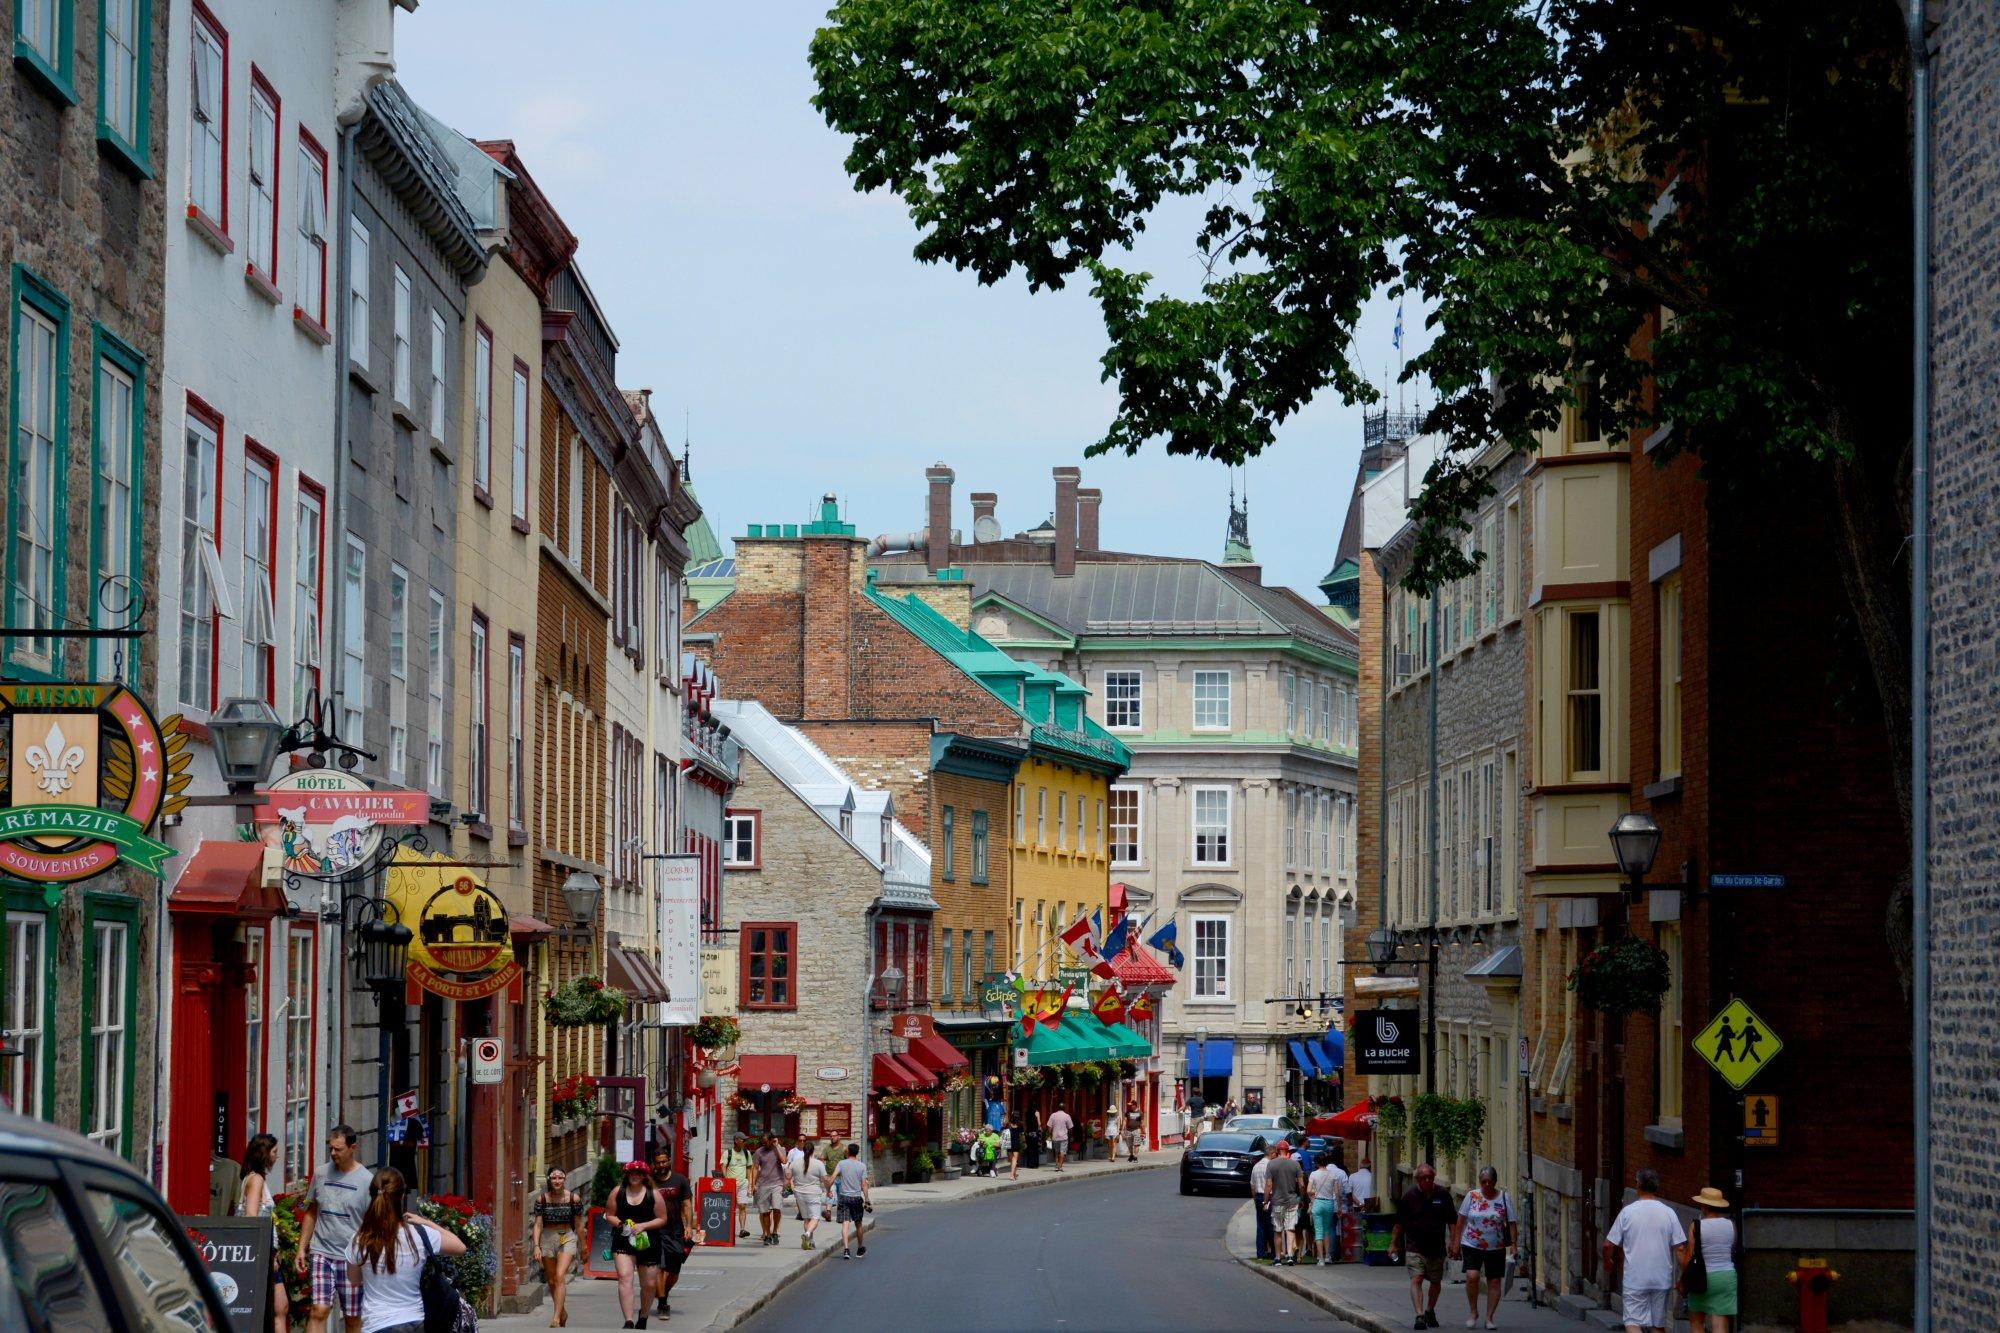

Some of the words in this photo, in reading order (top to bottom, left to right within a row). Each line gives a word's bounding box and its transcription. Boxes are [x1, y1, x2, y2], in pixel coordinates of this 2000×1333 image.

[14, 687, 96, 705] MAISON
[297, 775, 346, 790] HÔTEL
[309, 797, 394, 810] CAVALIER
[354, 809, 368, 819] du
[371, 809, 405, 819] moulin
[6, 852, 99, 873] SOUVENIRS
[442, 948, 487, 966] SOUVENIRS
[700, 952, 720, 960] Hôtel
[413, 966, 426, 979] LA
[427, 979, 463, 996] PORTE
[986, 986, 1018, 1004] Eclipse
[703, 1197, 731, 1207] POUTINE
[199, 1240, 256, 1262] ÔTEL
